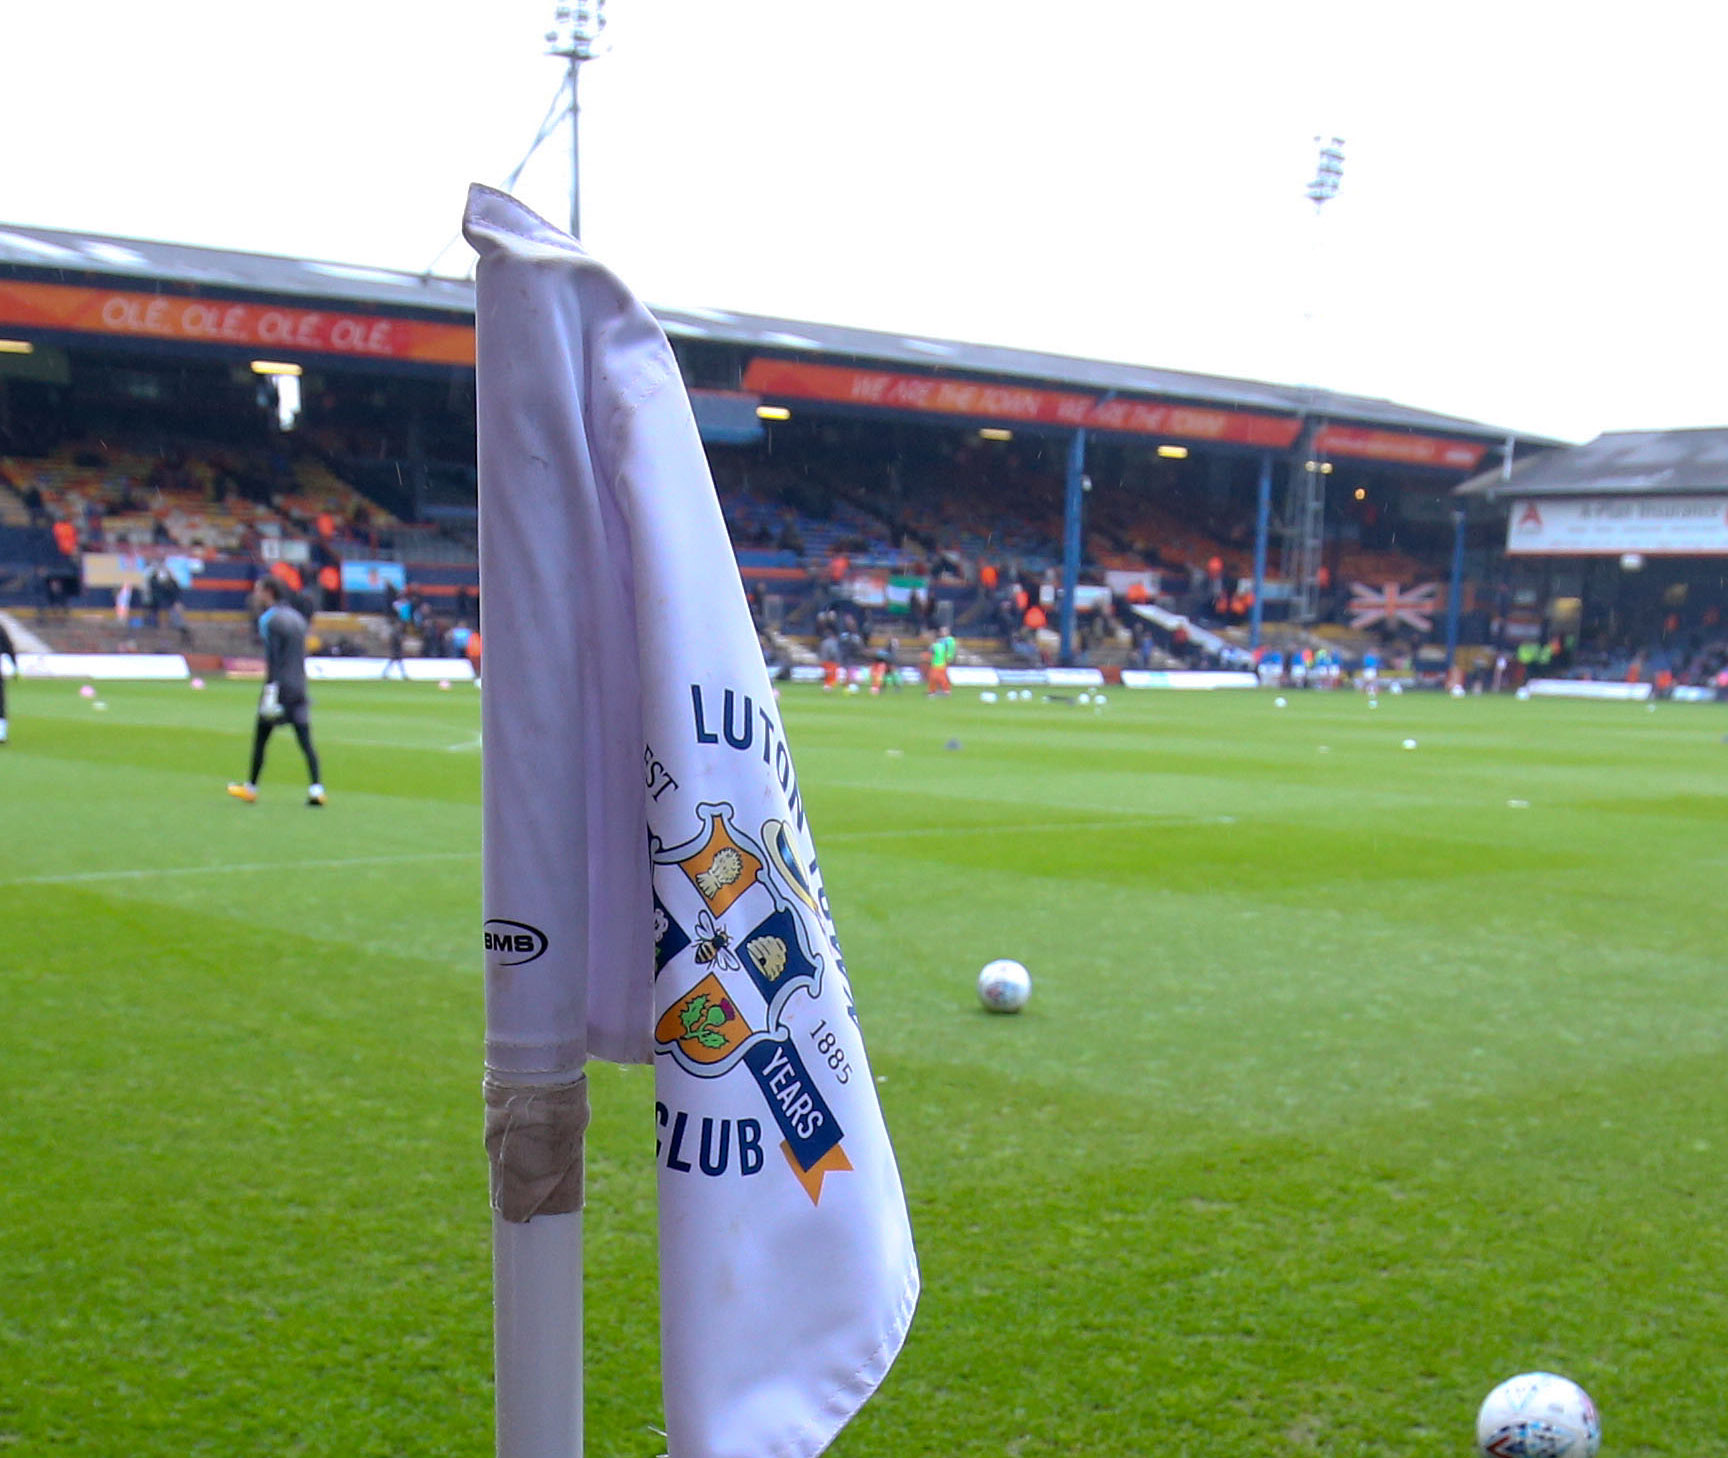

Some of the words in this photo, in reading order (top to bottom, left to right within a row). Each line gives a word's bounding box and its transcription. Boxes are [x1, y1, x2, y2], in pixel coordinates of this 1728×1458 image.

[690, 683, 804, 834] LUTON
[762, 1047, 824, 1139] YEARS
[810, 1019, 853, 1085] 1885
